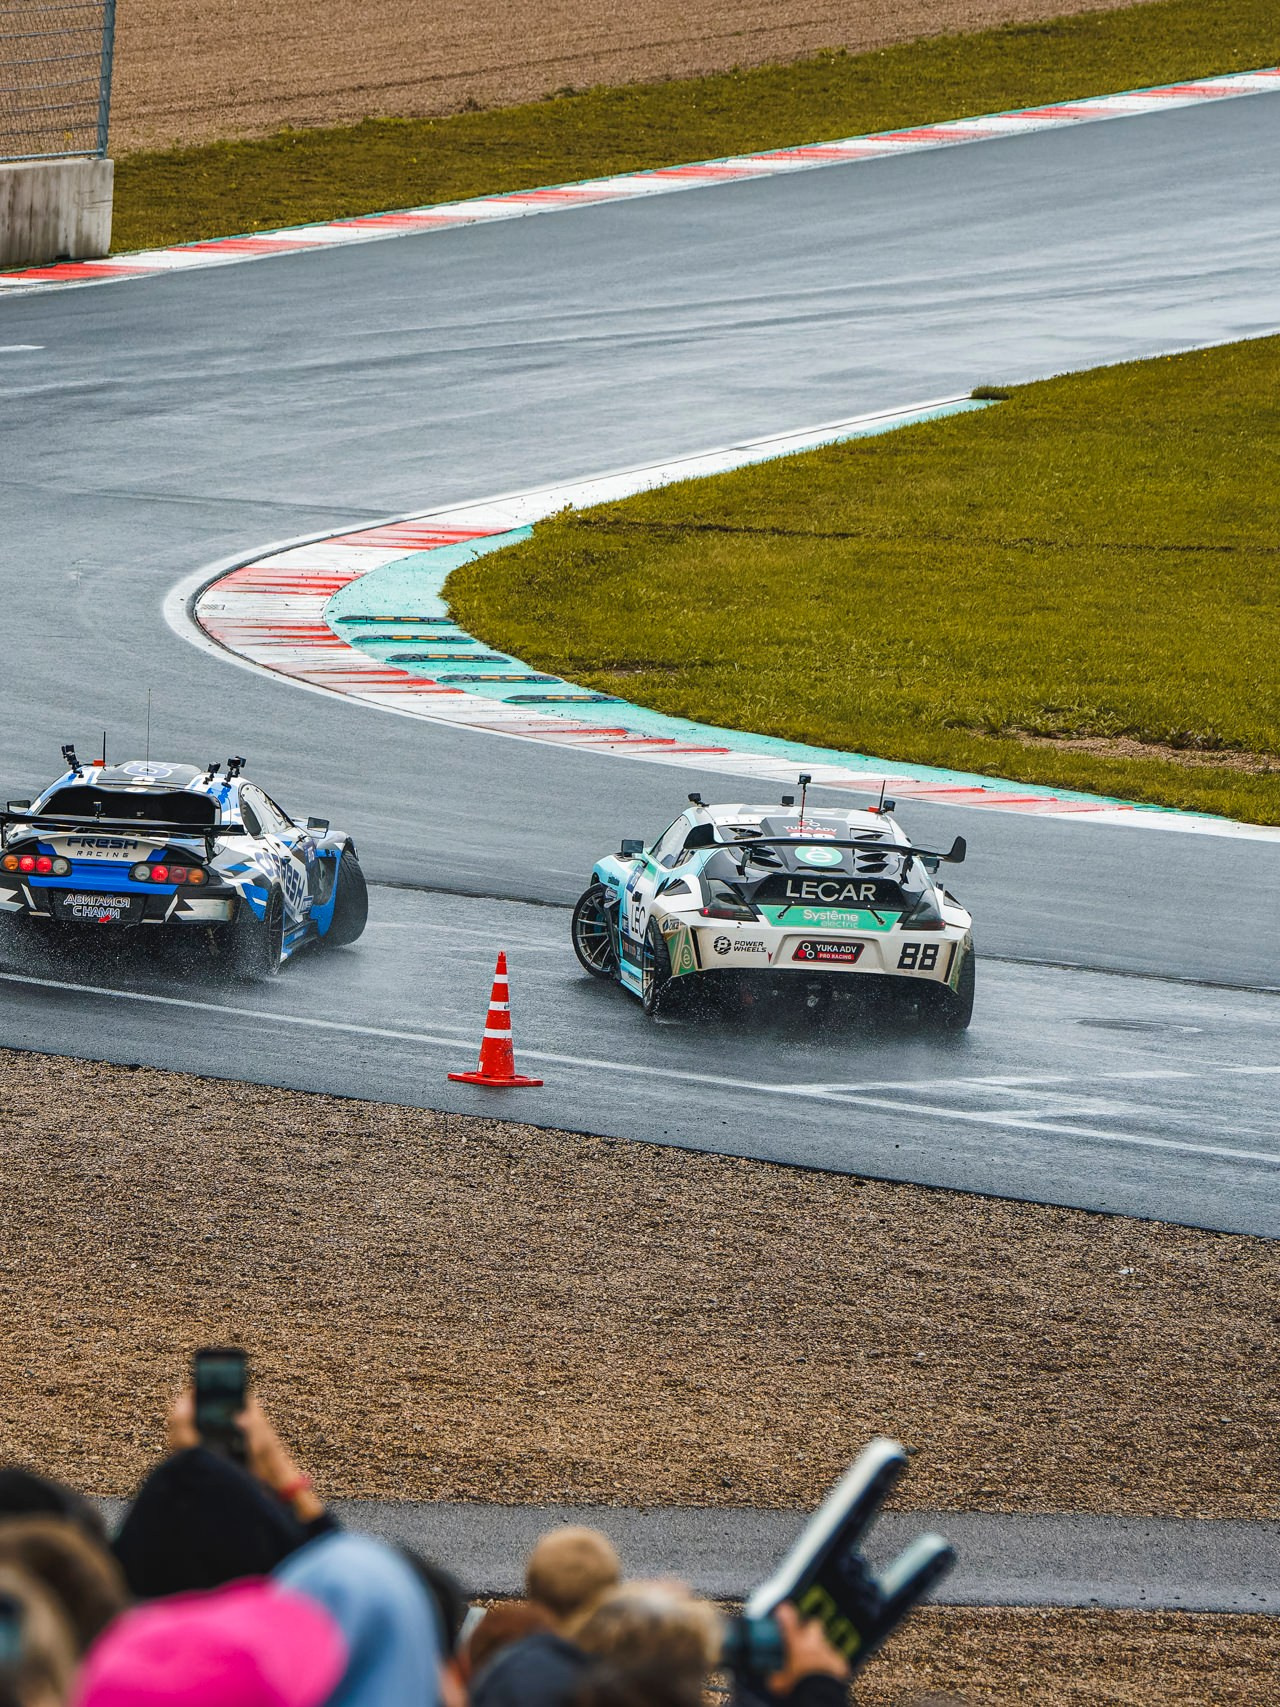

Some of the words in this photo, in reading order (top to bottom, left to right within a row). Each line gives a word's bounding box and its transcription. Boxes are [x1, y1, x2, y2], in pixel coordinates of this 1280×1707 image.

[76, 850, 129, 858] RACING
[786, 879, 877, 902] LECAR
[63, 893, 131, 908] ДВИГАЙСЯ
[82, 906, 120, 919] НАМИ
[803, 909, 859, 922] Système
[821, 919, 858, 928] electric
[815, 944, 839, 953] YUKA
[839, 945, 857, 954] ADV
[897, 942, 940, 971] 88
